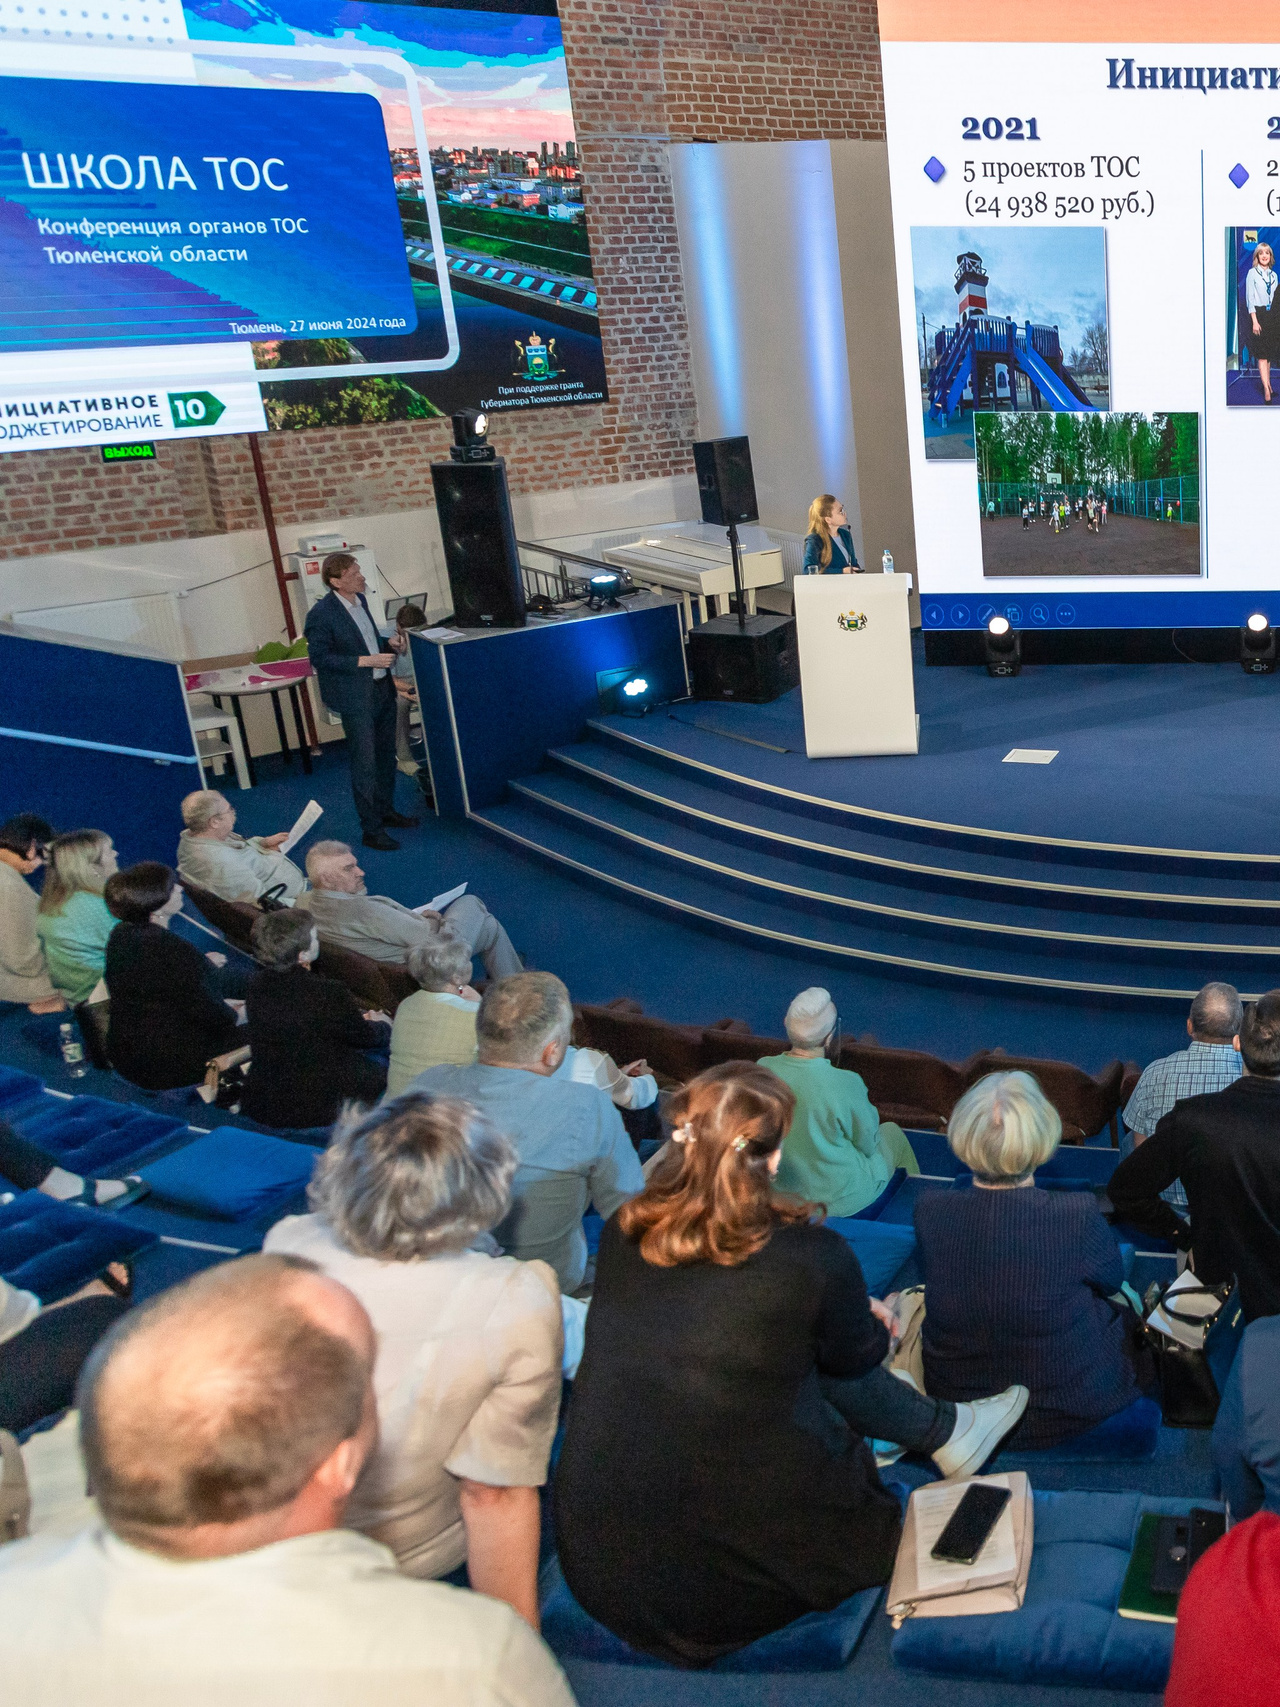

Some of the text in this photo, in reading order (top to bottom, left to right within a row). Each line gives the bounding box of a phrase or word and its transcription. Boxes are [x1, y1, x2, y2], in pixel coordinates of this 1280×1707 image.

[961, 117, 1041, 140] 2021
[22, 152, 289, 191] ШКОЛА ТОС
[963, 155, 1141, 184] 5 проектов ТОС
[1266, 159, 1279, 177] 2
[965, 190, 1155, 219] (24 938 520 руб.)
[37, 217, 309, 238] Конференция органов ТОС
[43, 245, 248, 264] Тюменской области
[229, 317, 406, 335] Тюмень, 27 июня 2024 года
[498, 381, 584, 395] При поддержке гранта
[174, 398, 206, 420] 10
[480, 391, 603, 409] Губернатора Тюменской области
[104, 444, 154, 459] ВЫХОД
